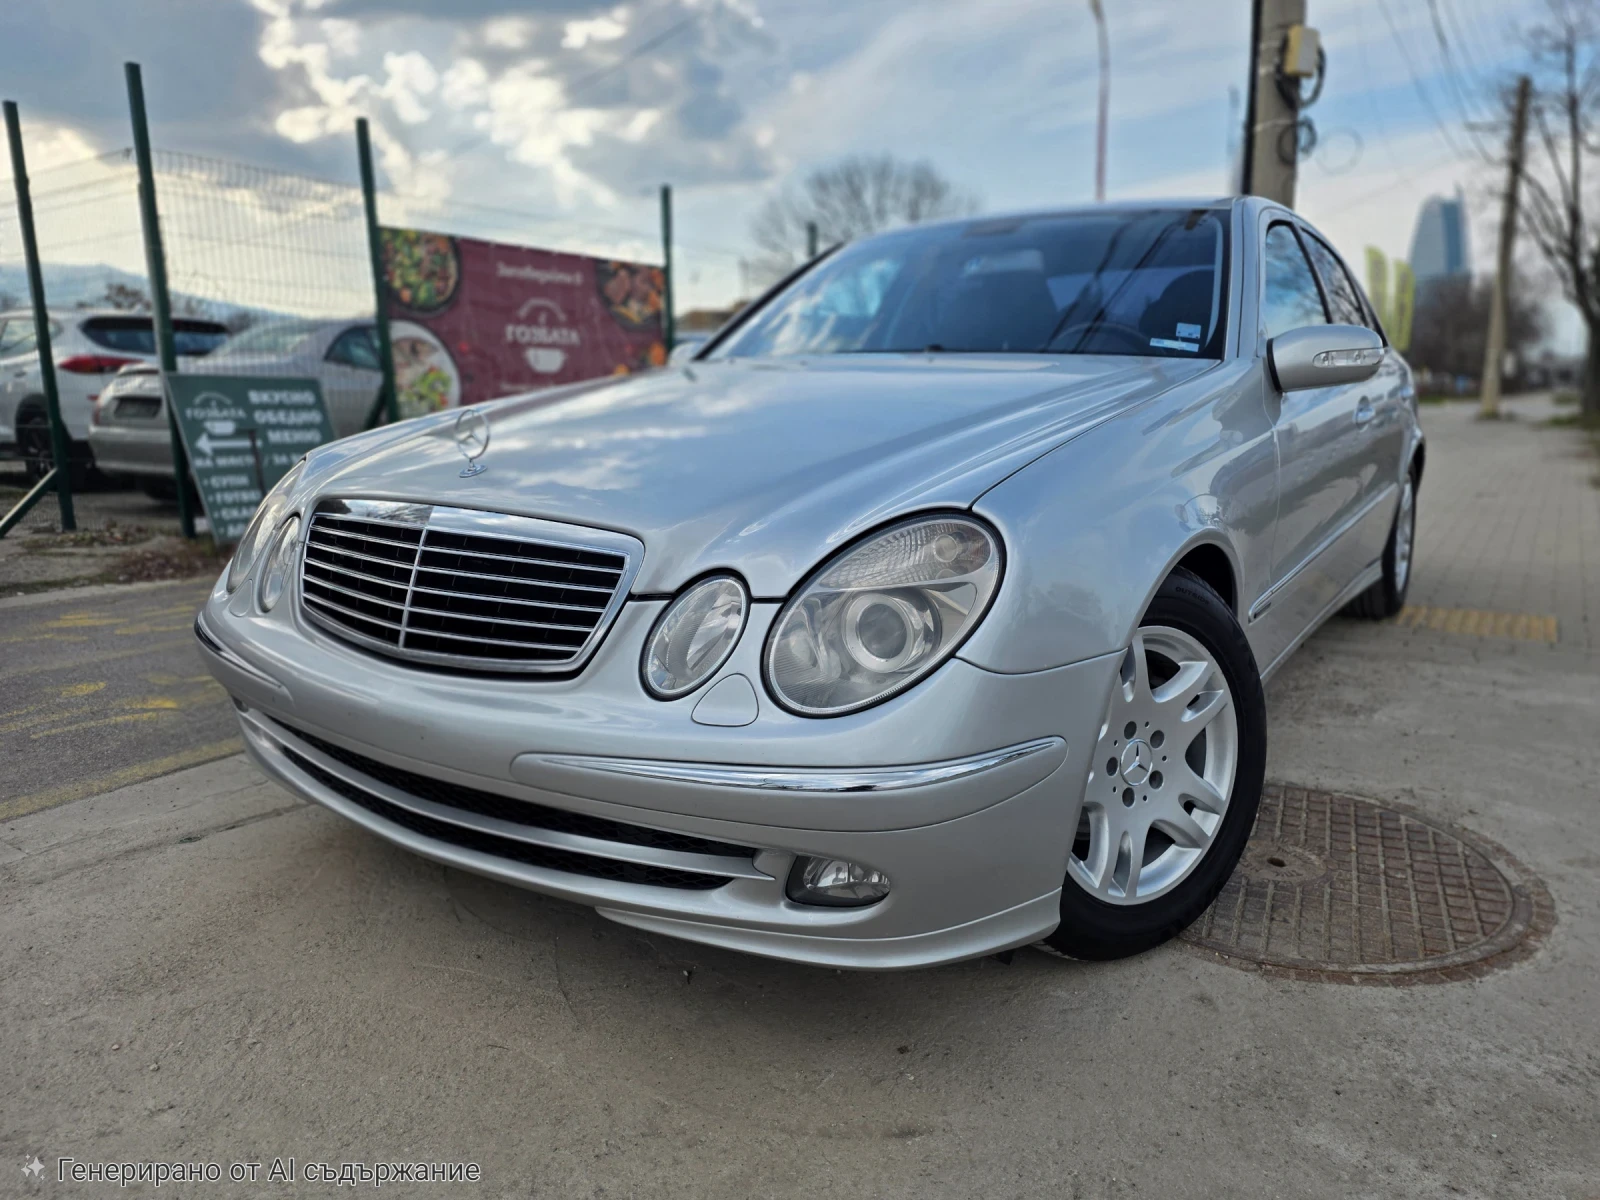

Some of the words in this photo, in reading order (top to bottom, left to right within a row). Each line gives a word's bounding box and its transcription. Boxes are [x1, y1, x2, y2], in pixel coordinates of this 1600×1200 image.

[248, 390, 315, 404] ВКУСНО
[253, 410, 322, 424] ОБЕДНО
[267, 430, 321, 443] МЕНЮ
[1175, 586, 1210, 605] OUTSIDE
